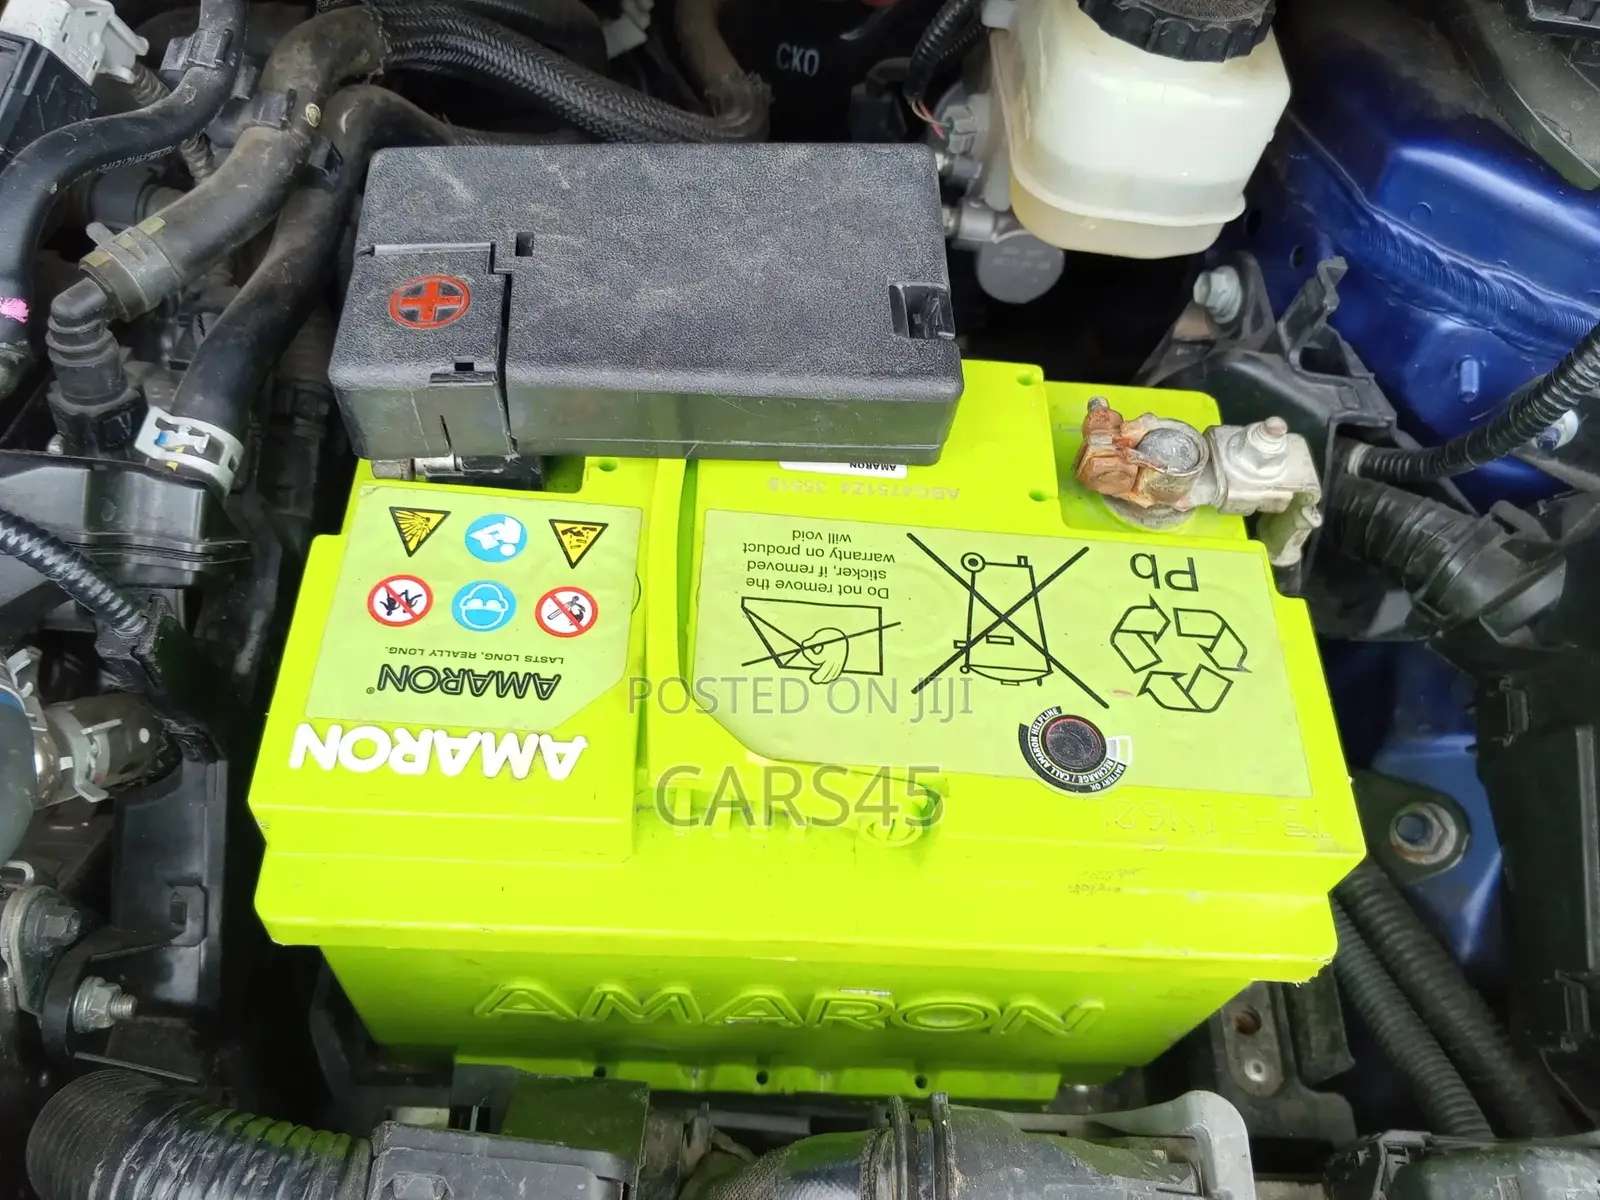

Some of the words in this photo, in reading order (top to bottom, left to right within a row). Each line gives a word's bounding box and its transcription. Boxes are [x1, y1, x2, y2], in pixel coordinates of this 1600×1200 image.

[849, 462, 897, 471] AMARON
[792, 529, 823, 542] void
[828, 533, 852, 544] will
[742, 542, 800, 556] product
[806, 547, 825, 557] on
[829, 547, 896, 563] warranty
[747, 560, 814, 574] removed
[818, 566, 828, 578] if
[833, 564, 887, 580] sticker,
[1129, 552, 1199, 592] Pb
[746, 577, 770, 590] the
[775, 580, 833, 593] remove
[838, 584, 862, 596] not
[867, 586, 889, 599] Do
[429, 649, 477, 659] REALLY
[524, 655, 565, 665] LASTS
[1030, 707, 1059, 736] HELPLINE
[288, 722, 589, 781] AMARON
[1030, 736, 1052, 768] AMARON
[1051, 768, 1070, 782] CALL
[1078, 760, 1114, 784] RECHARGE
[1102, 764, 1126, 788] BATTERY
[1090, 782, 1101, 792] OK
[473, 980, 1106, 1036] AMARON
